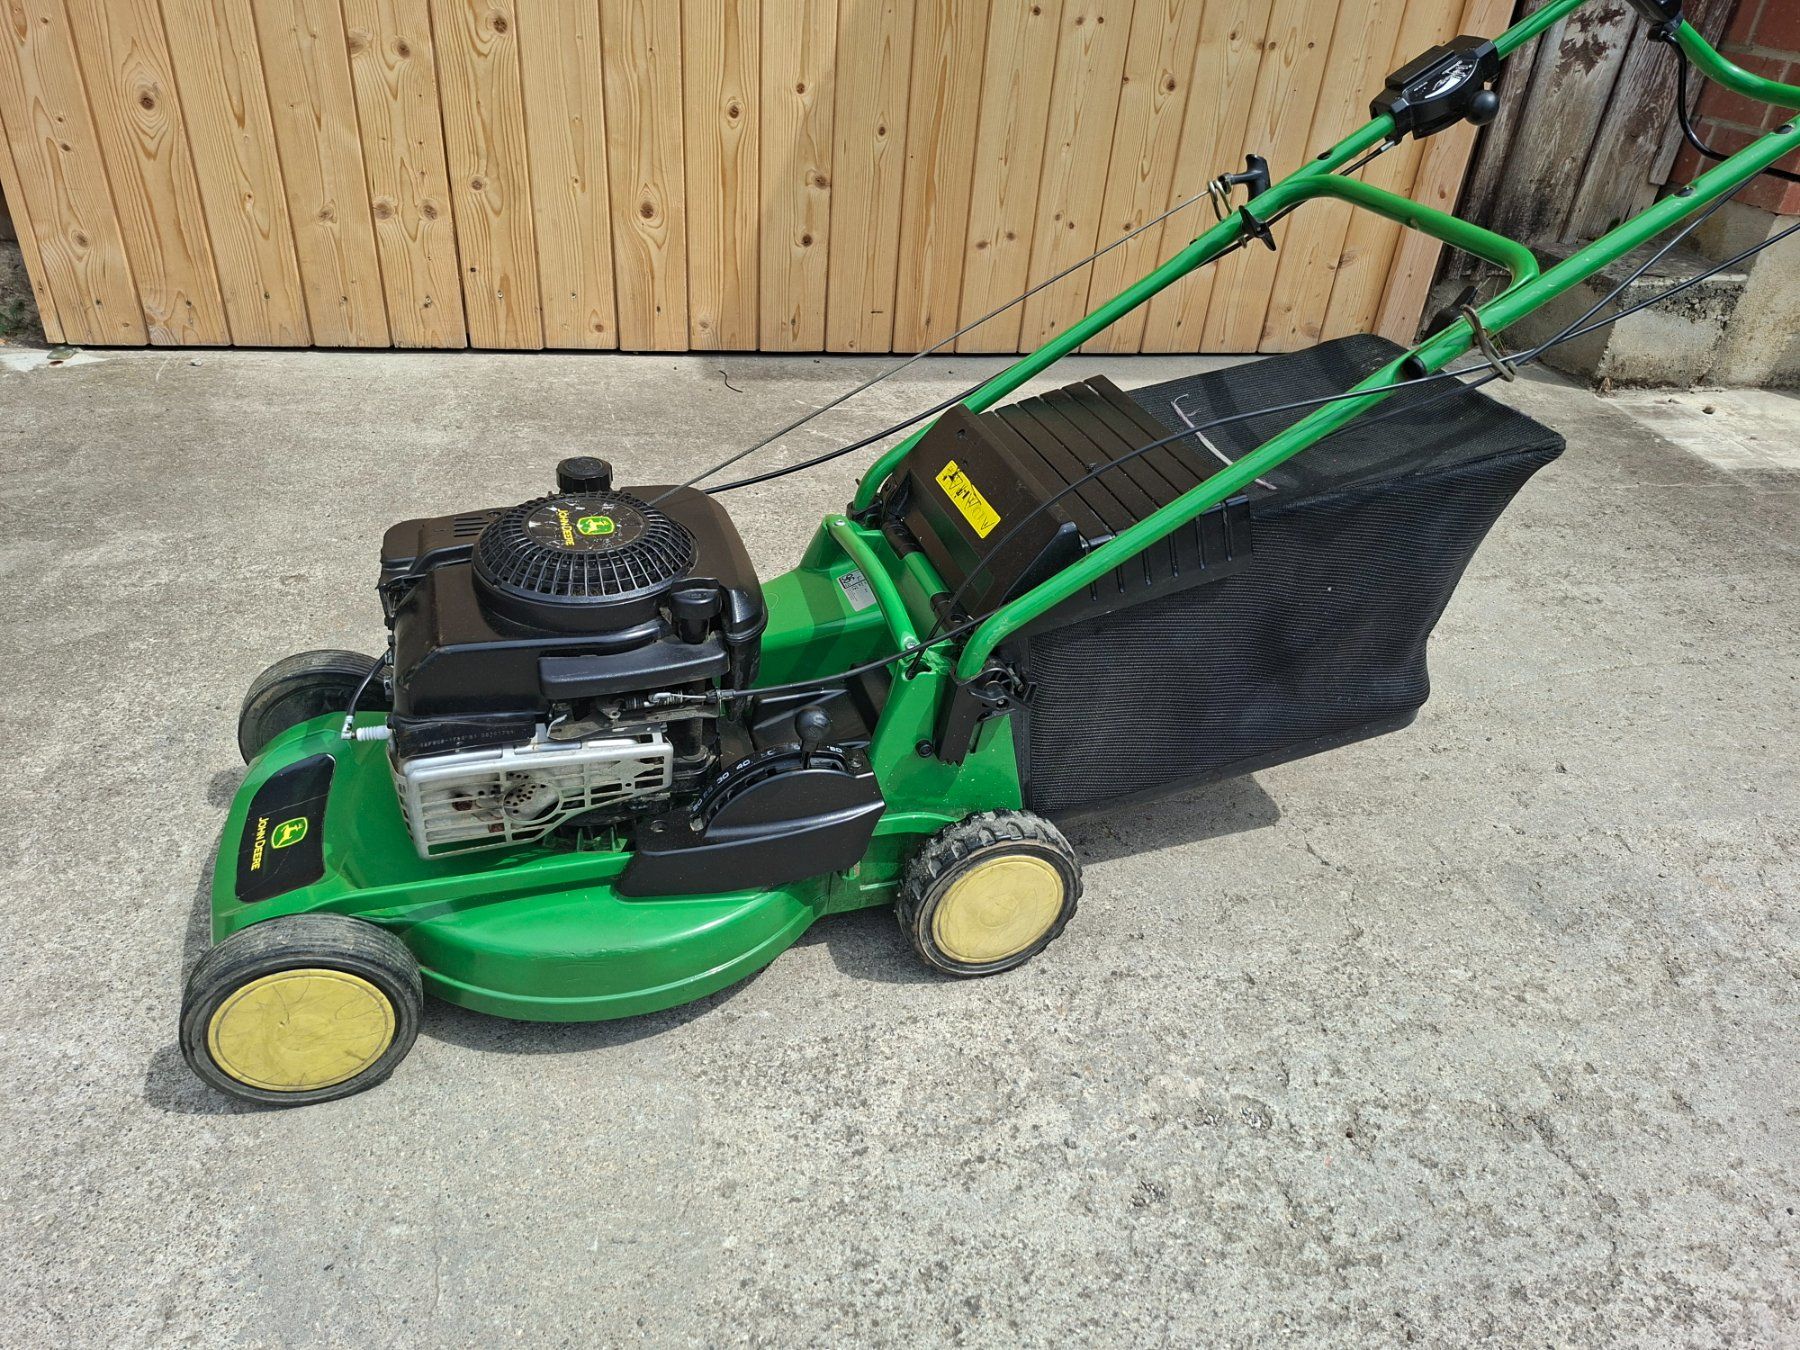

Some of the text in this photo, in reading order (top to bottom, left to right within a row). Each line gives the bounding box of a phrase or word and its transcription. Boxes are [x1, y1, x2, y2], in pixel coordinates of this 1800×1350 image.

[557, 508, 575, 546] JOHN DEERE
[736, 759, 751, 770] 40
[716, 771, 730, 784] 30
[250, 817, 270, 871] JOHN DEERE
